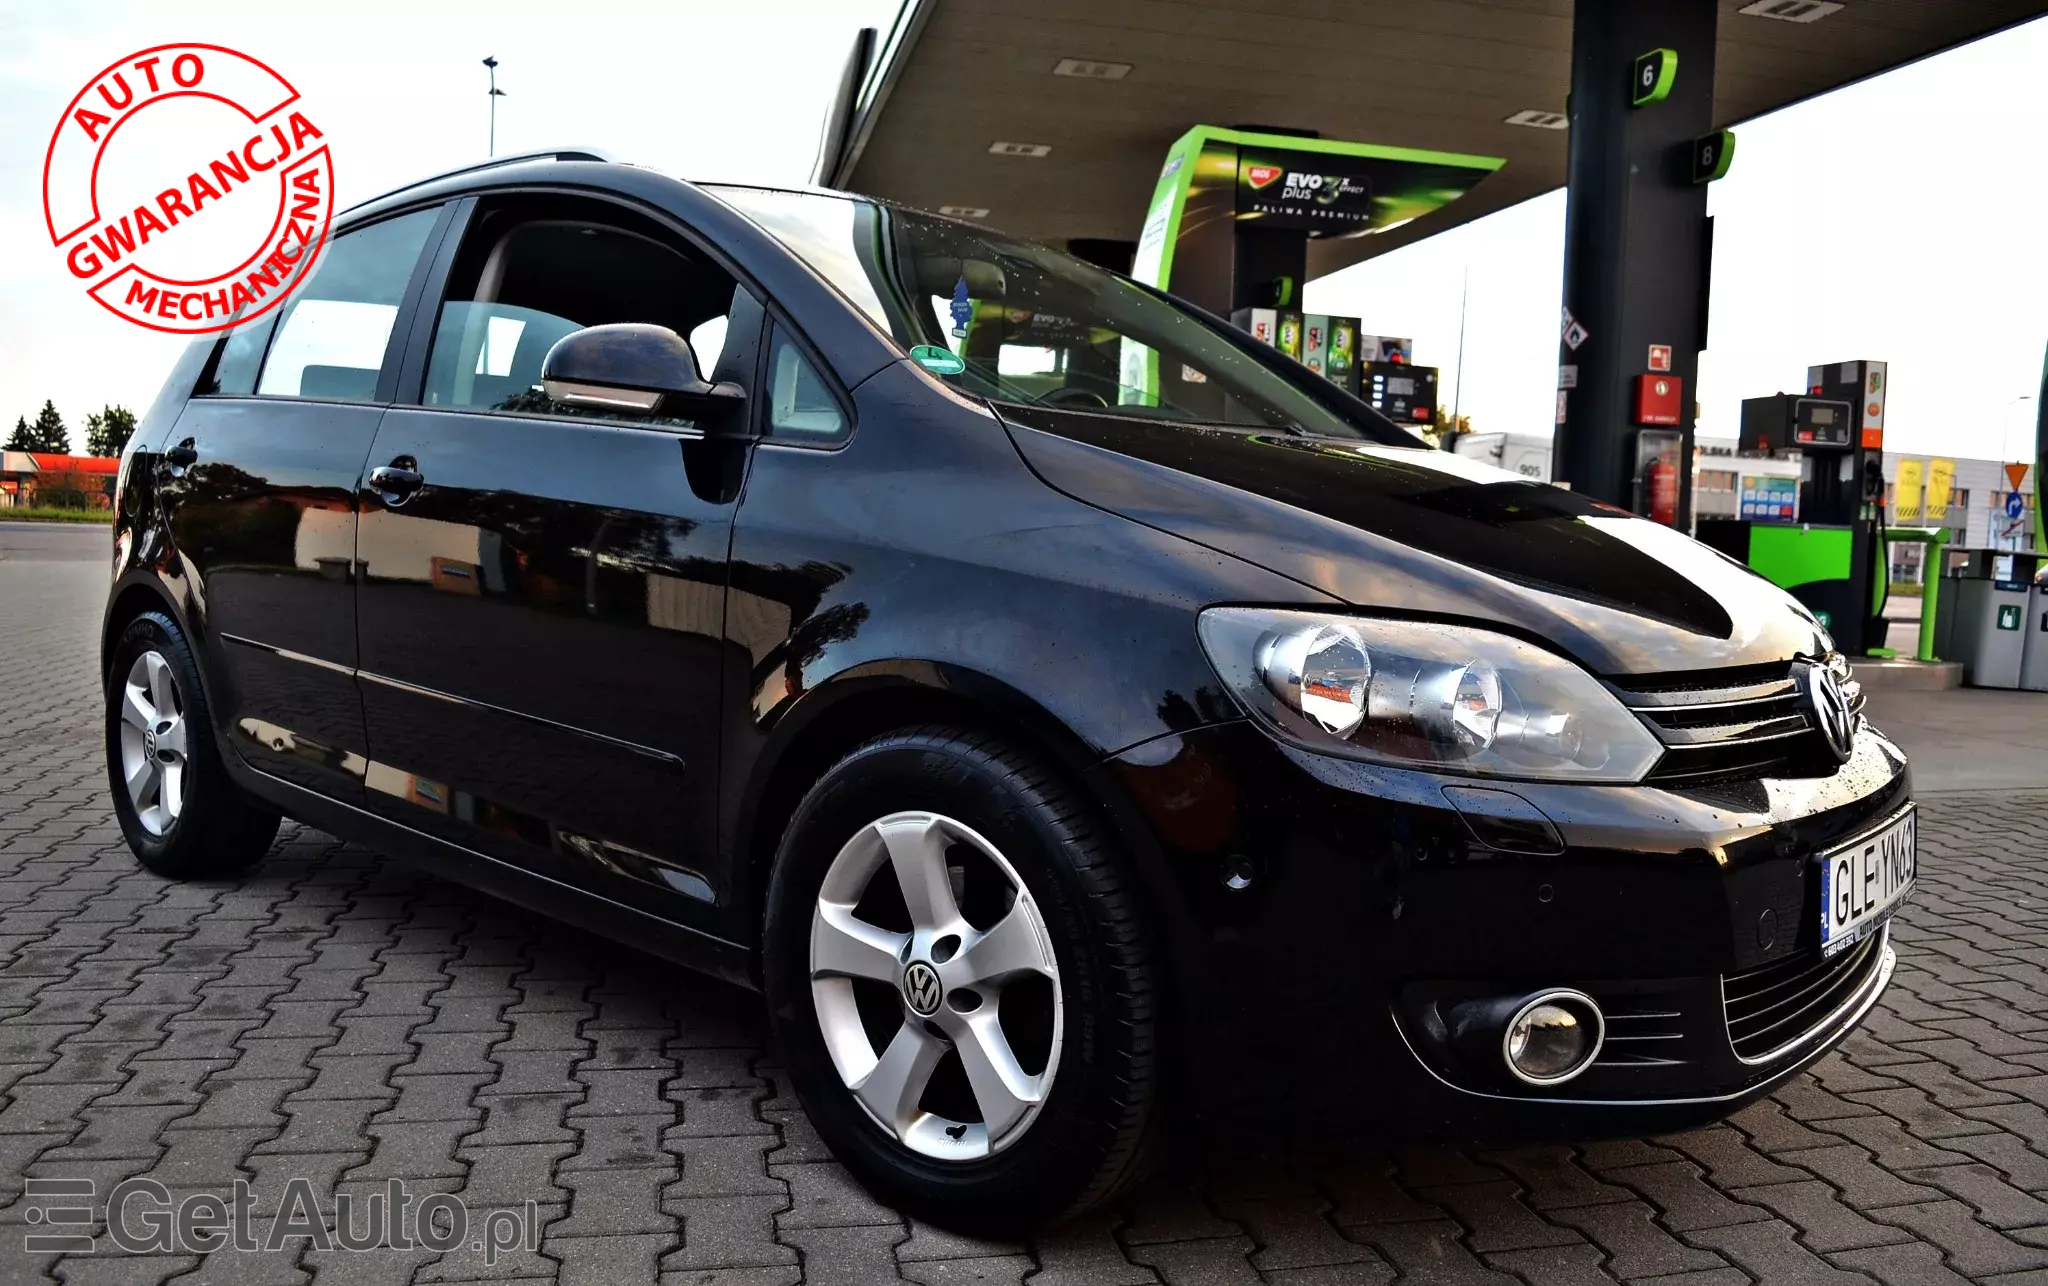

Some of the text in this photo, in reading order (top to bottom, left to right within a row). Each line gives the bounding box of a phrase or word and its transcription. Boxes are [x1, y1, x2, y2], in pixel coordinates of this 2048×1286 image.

[1642, 64, 1654, 87] 6
[1701, 145, 1713, 167] 8
[1285, 172, 1323, 189] EVO
[1282, 187, 1313, 200] plus
[1253, 204, 1370, 221] PALIWA PREMIUM
[1520, 464, 1541, 477] 905
[1836, 820, 1912, 926] GLE YN63
